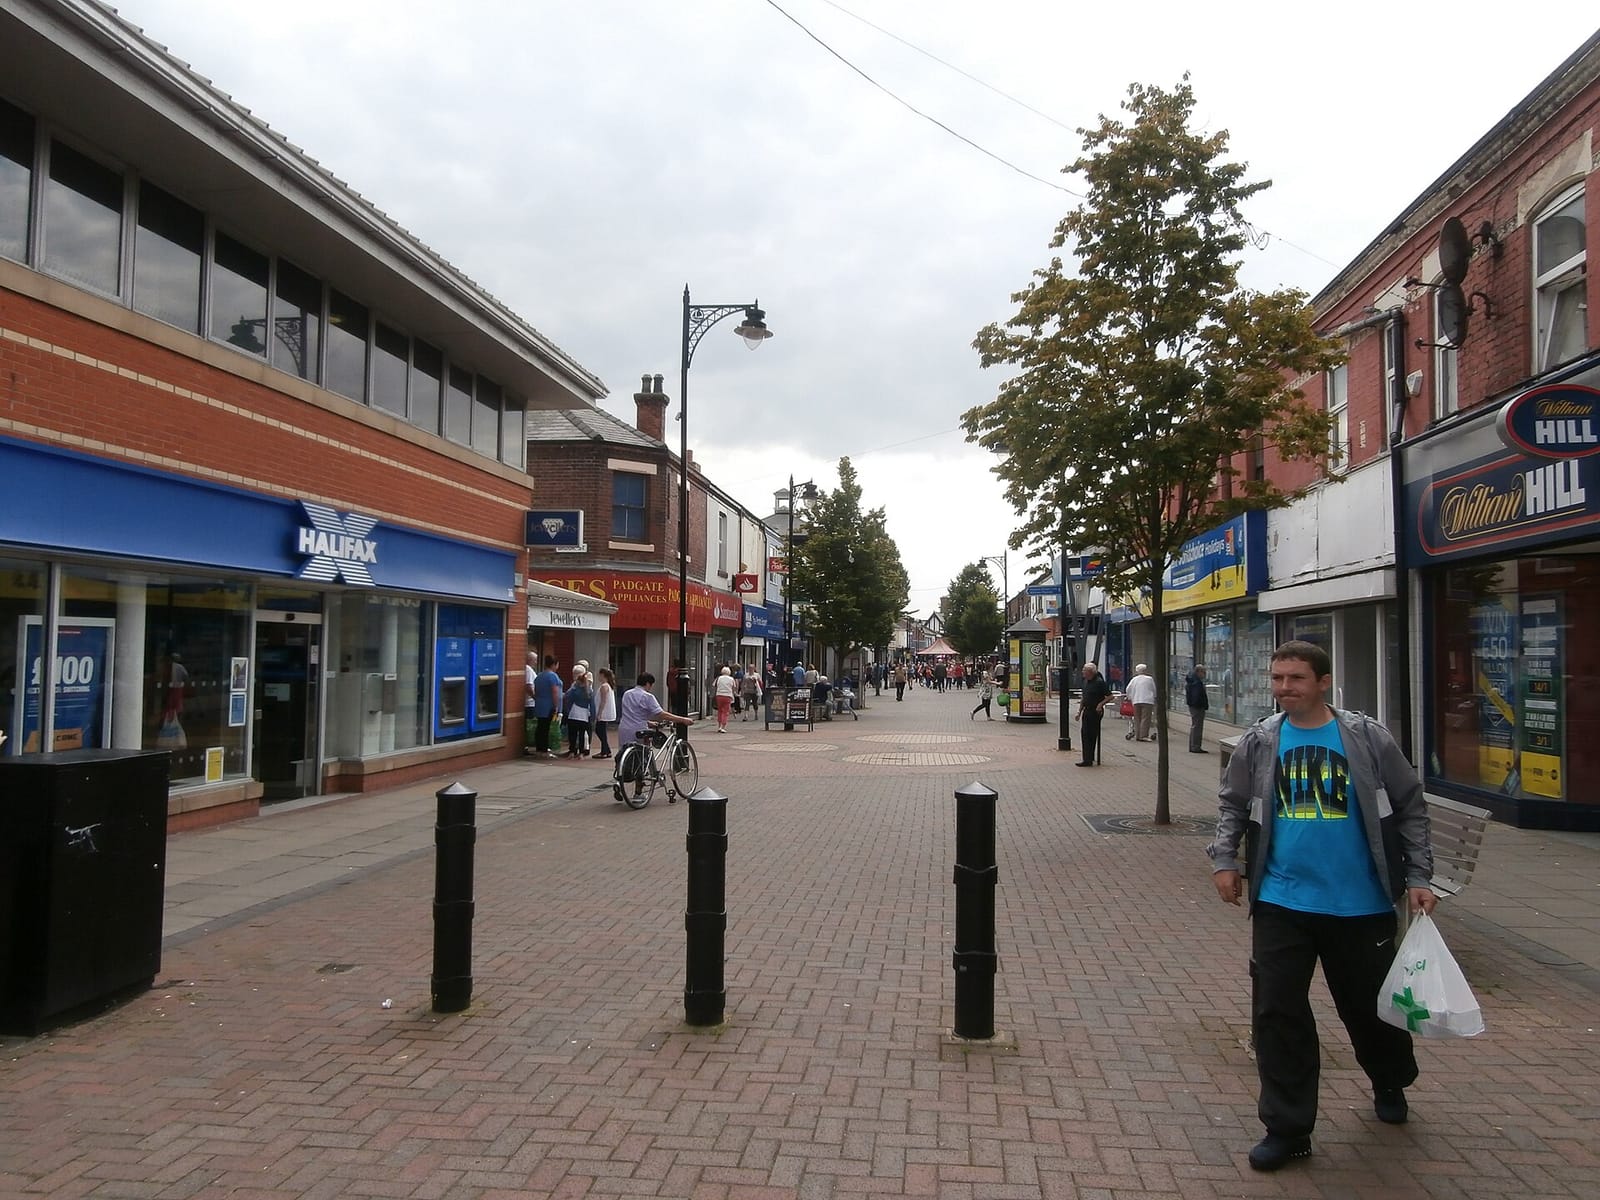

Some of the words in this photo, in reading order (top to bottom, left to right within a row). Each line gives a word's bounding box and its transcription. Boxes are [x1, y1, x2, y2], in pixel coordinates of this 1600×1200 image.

[1536, 399, 1592, 416] William
[1535, 420, 1598, 444] HILL
[1441, 474, 1525, 535] William
[1526, 459, 1585, 516] HILL
[299, 528, 377, 564] HALIFAX
[613, 580, 665, 592] PADGATE
[612, 594, 667, 603] APPLIANCES
